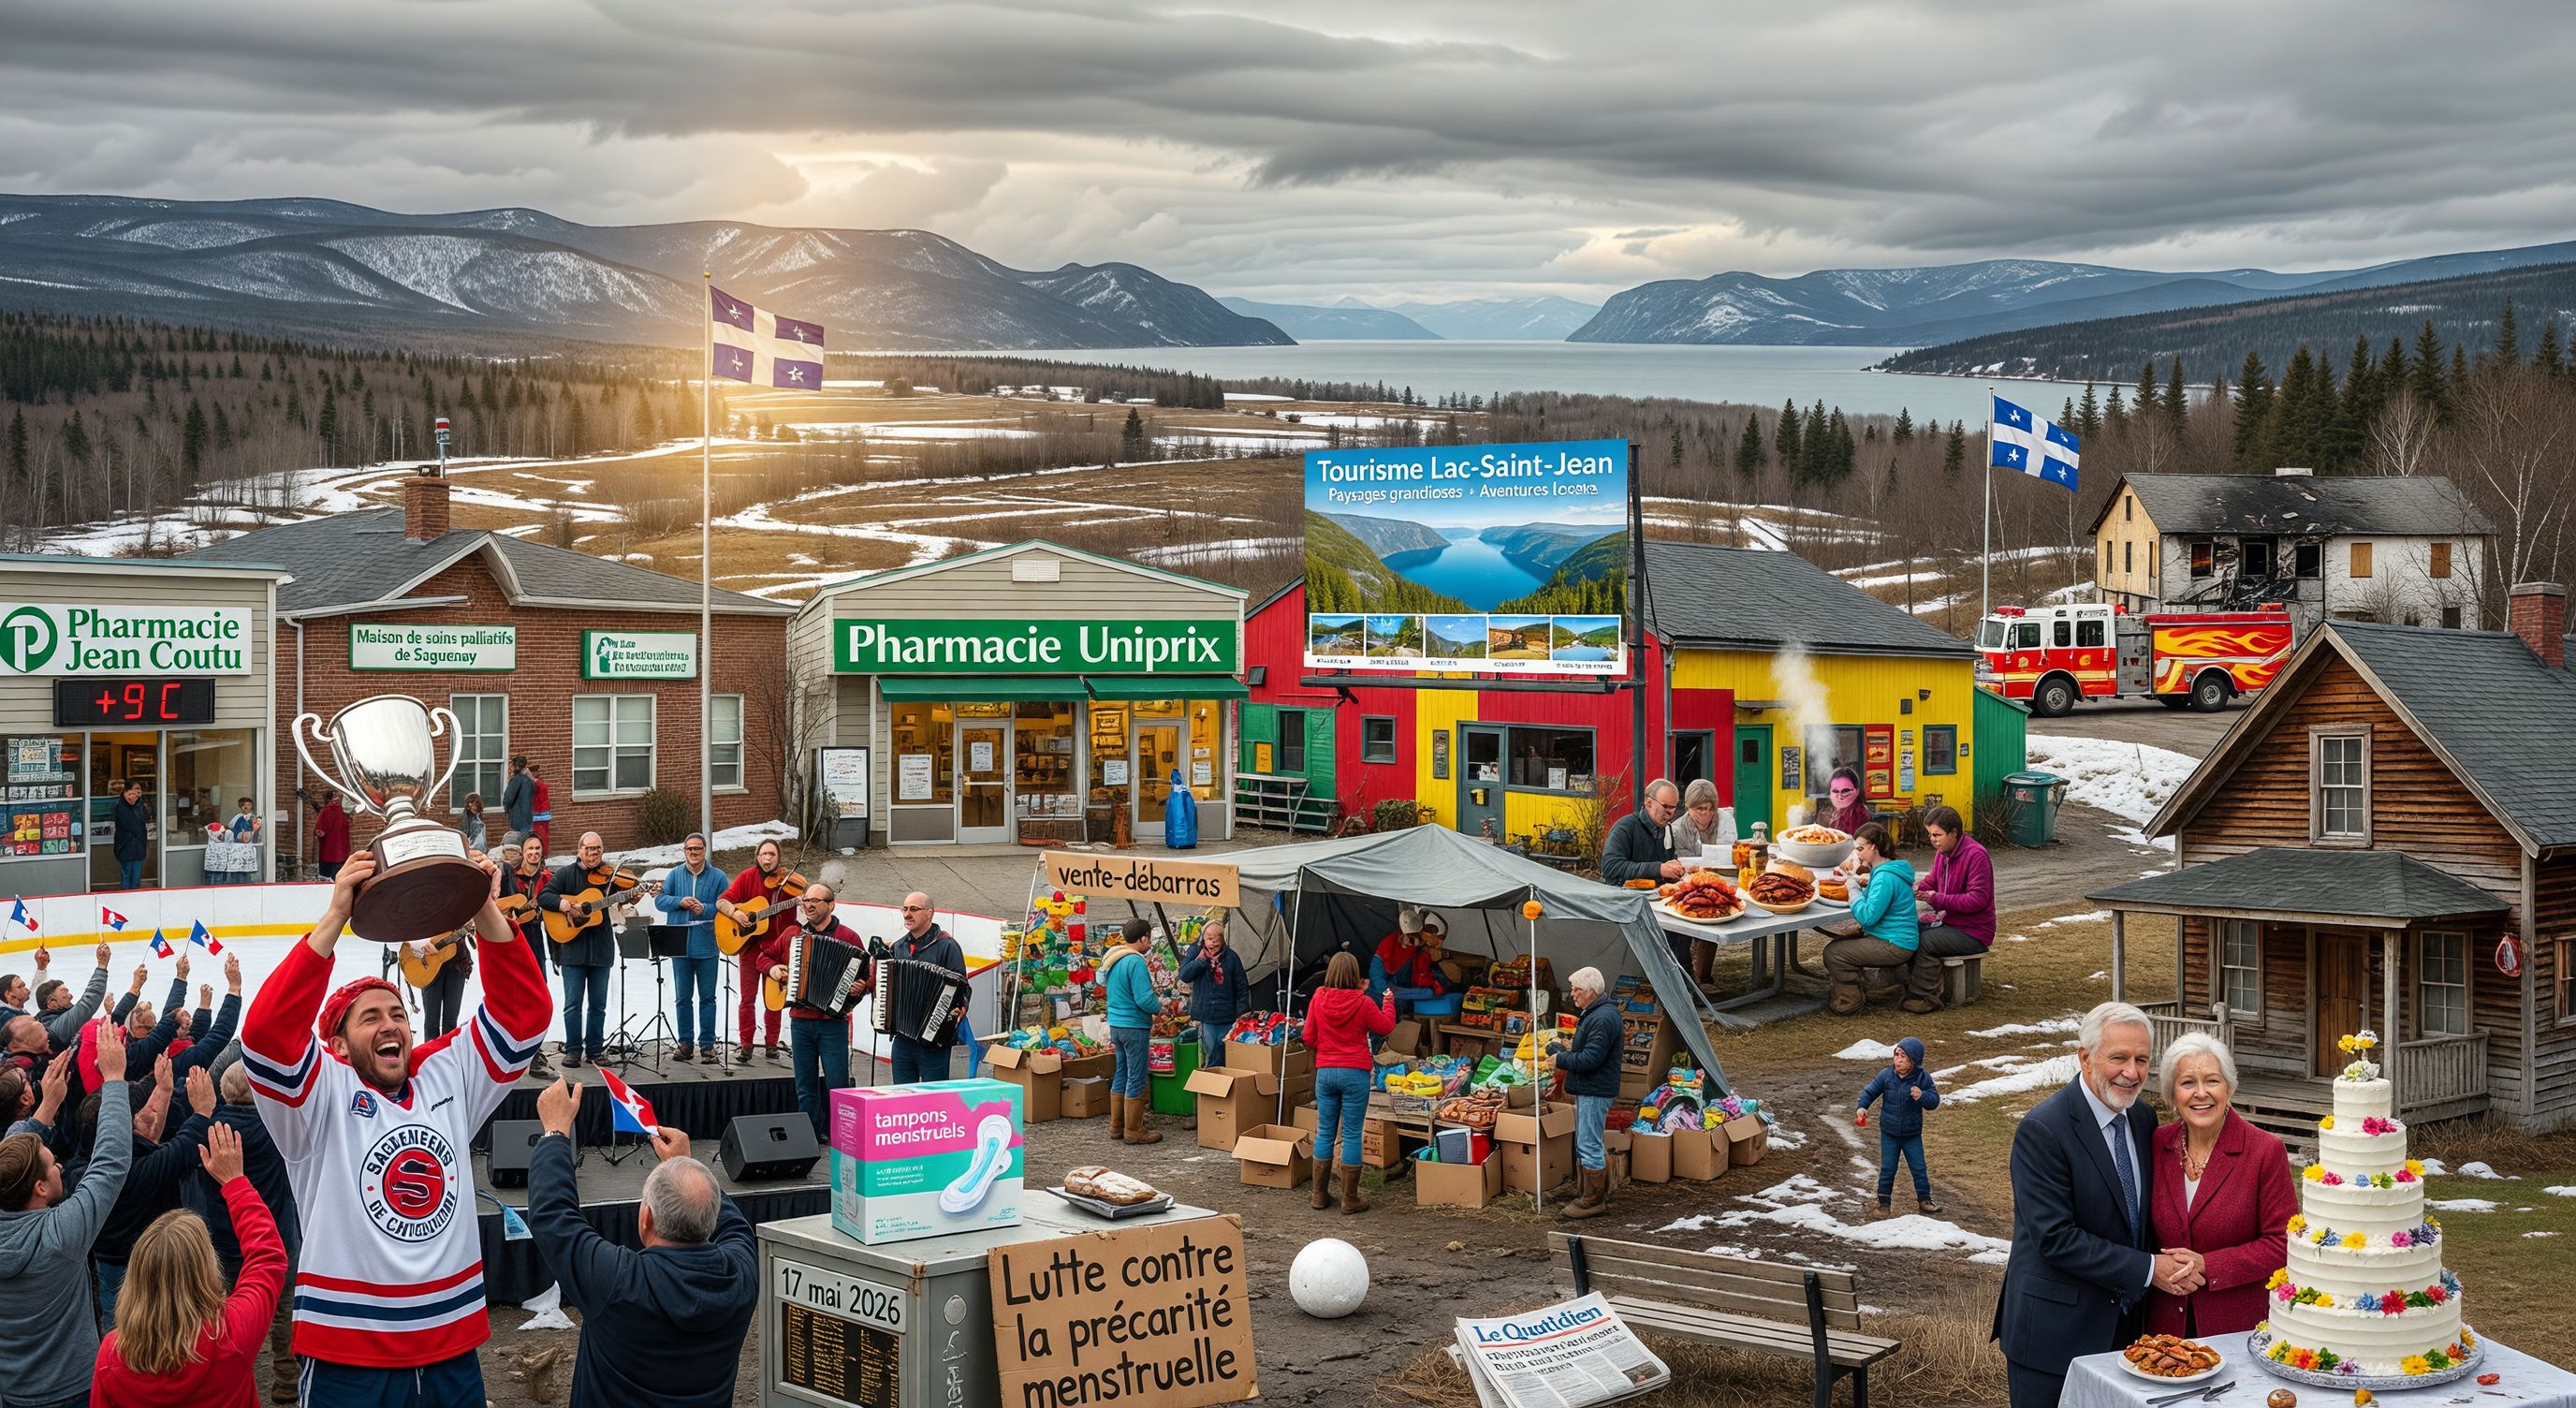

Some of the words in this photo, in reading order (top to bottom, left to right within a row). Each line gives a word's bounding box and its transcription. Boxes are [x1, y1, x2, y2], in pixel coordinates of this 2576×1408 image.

[1317, 458, 1424, 483] Tourisme
[1431, 452, 1614, 480] Lac-Saint-Jean
[1390, 485, 1463, 504] grandioses
[1480, 484, 1549, 498] Aventures
[66, 609, 241, 639] Pharmacie
[357, 629, 402, 643] Maison
[407, 630, 422, 644] de
[426, 631, 458, 644] soins
[66, 640, 141, 671] Jean
[150, 640, 242, 671] Coutu
[395, 648, 411, 661] de
[849, 623, 1061, 664] Pharmacie
[1079, 625, 1222, 672] Uniprix
[1058, 859, 1222, 898] vente-débarras
[875, 1109, 948, 1129] tampons
[875, 1122, 966, 1147] menstruels
[370, 1199, 388, 1220] DE
[1002, 1248, 1106, 1306] Lutte
[1122, 1235, 1234, 1287] contre
[782, 1267, 802, 1298] 17
[809, 1281, 842, 1309] mai
[849, 1284, 900, 1325] 2026
[1017, 1313, 1052, 1361] la
[1068, 1283, 1234, 1367] précarité
[1472, 1326, 1502, 1342] Le
[1023, 1336, 1238, 1408] menstruelle
